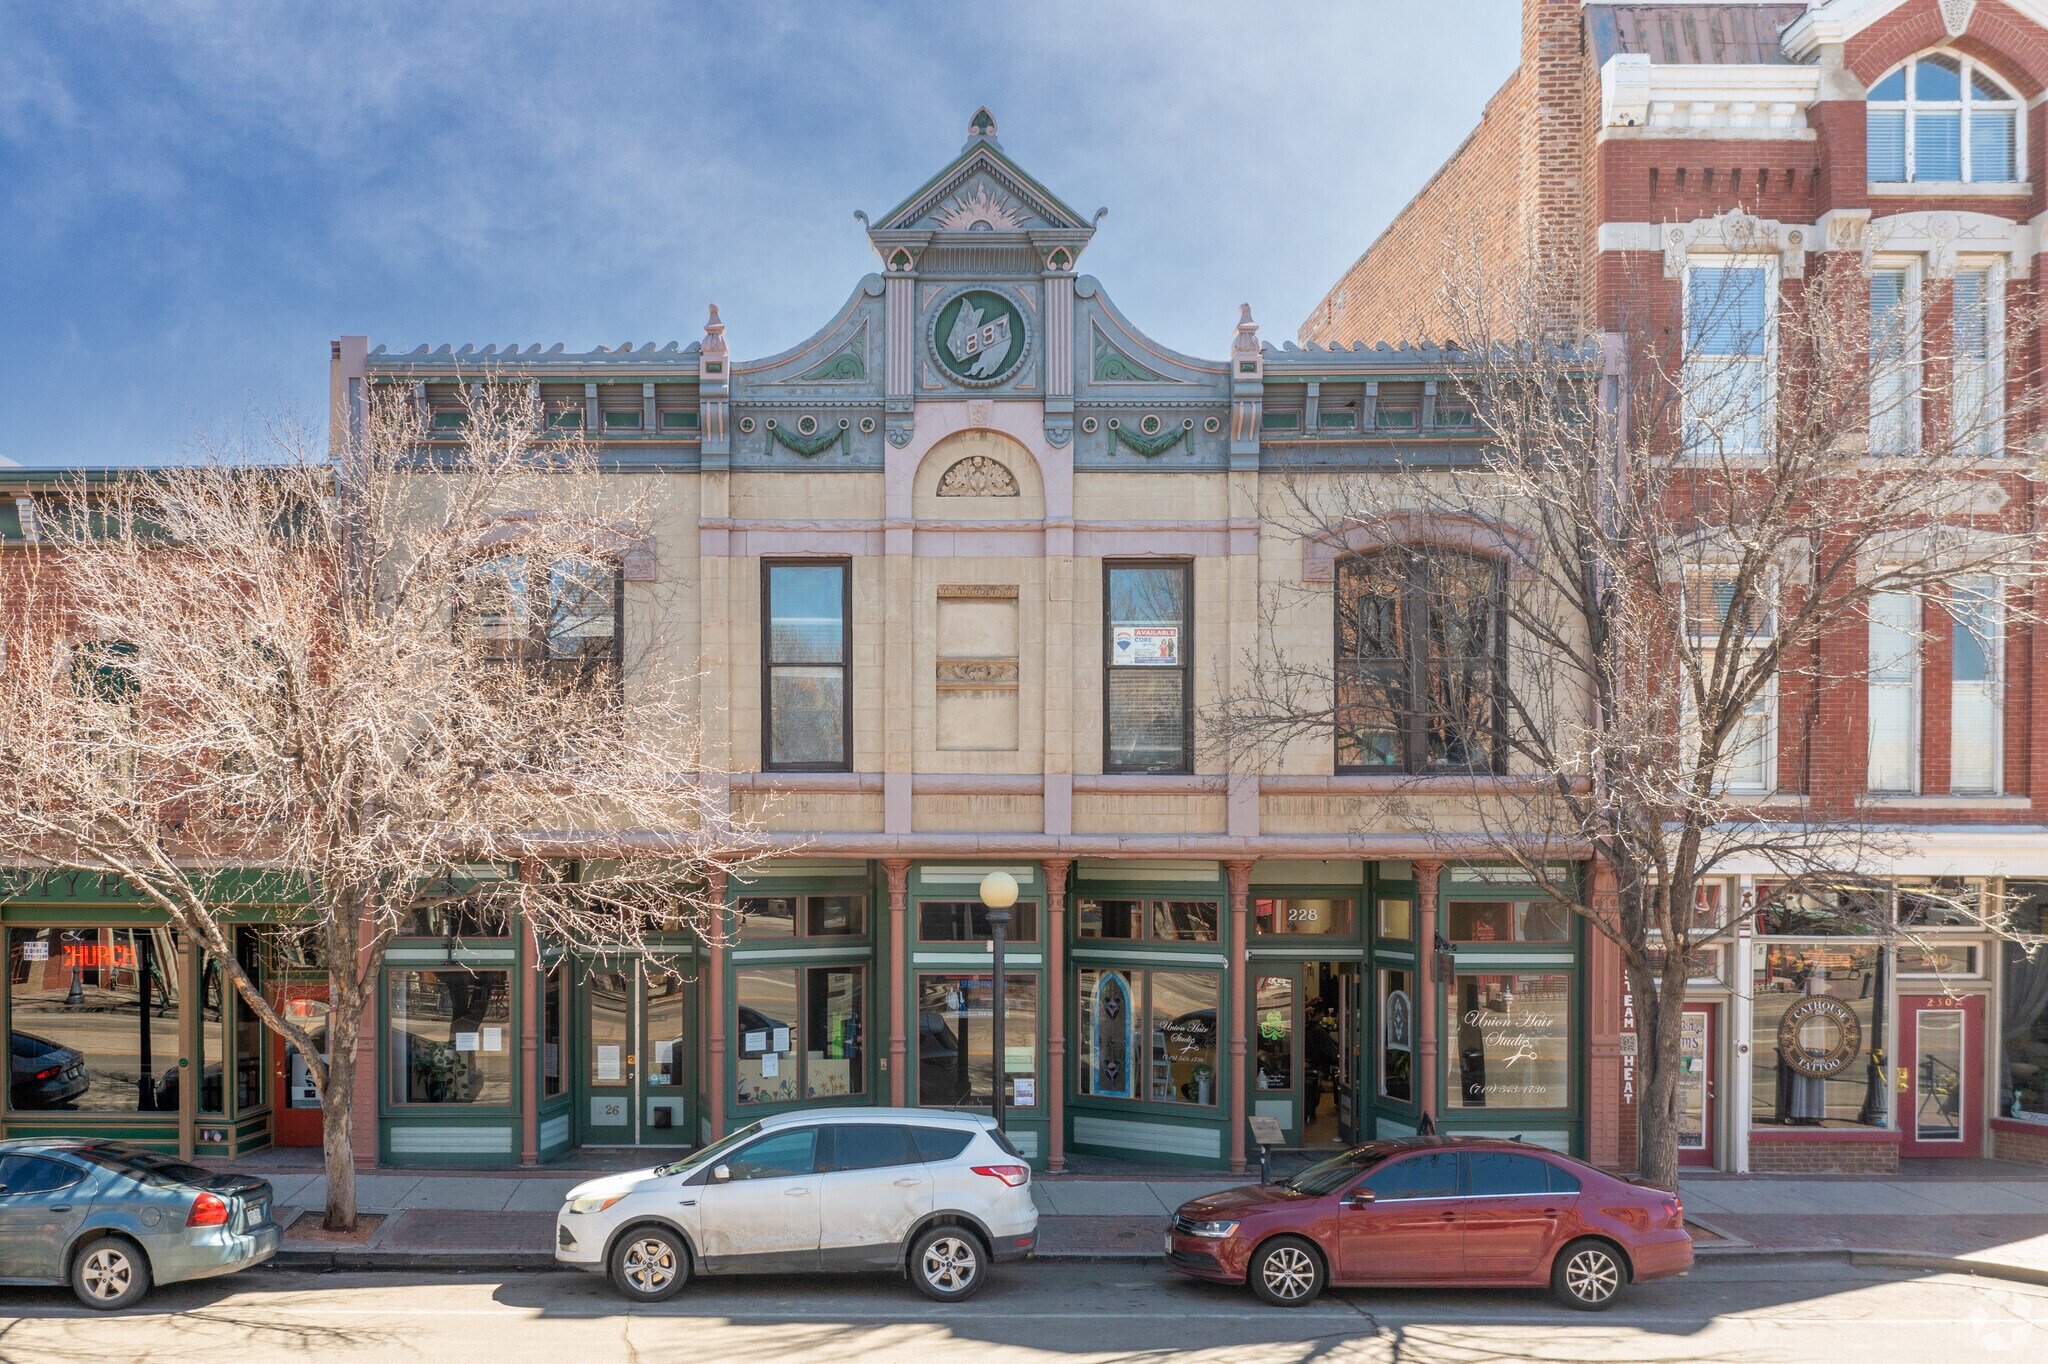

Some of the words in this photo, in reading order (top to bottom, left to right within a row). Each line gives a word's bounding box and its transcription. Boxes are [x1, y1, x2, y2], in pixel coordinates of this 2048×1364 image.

[956, 317, 1008, 360] 1887
[1288, 908, 1318, 921] 228
[1926, 997, 1952, 1007] 230
[1464, 1009, 1511, 1029] Union
[1516, 1009, 1554, 1028] Hair
[1793, 1001, 1848, 1021] CATHOUSE
[1159, 1020, 1185, 1032] Union
[1186, 1021, 1208, 1033] Hair
[1485, 1030, 1530, 1047] Studio
[1797, 1057, 1840, 1072] TATTOO
[1623, 1055, 1634, 1104] HEAT
[1469, 1082, 1497, 1095] (719)
